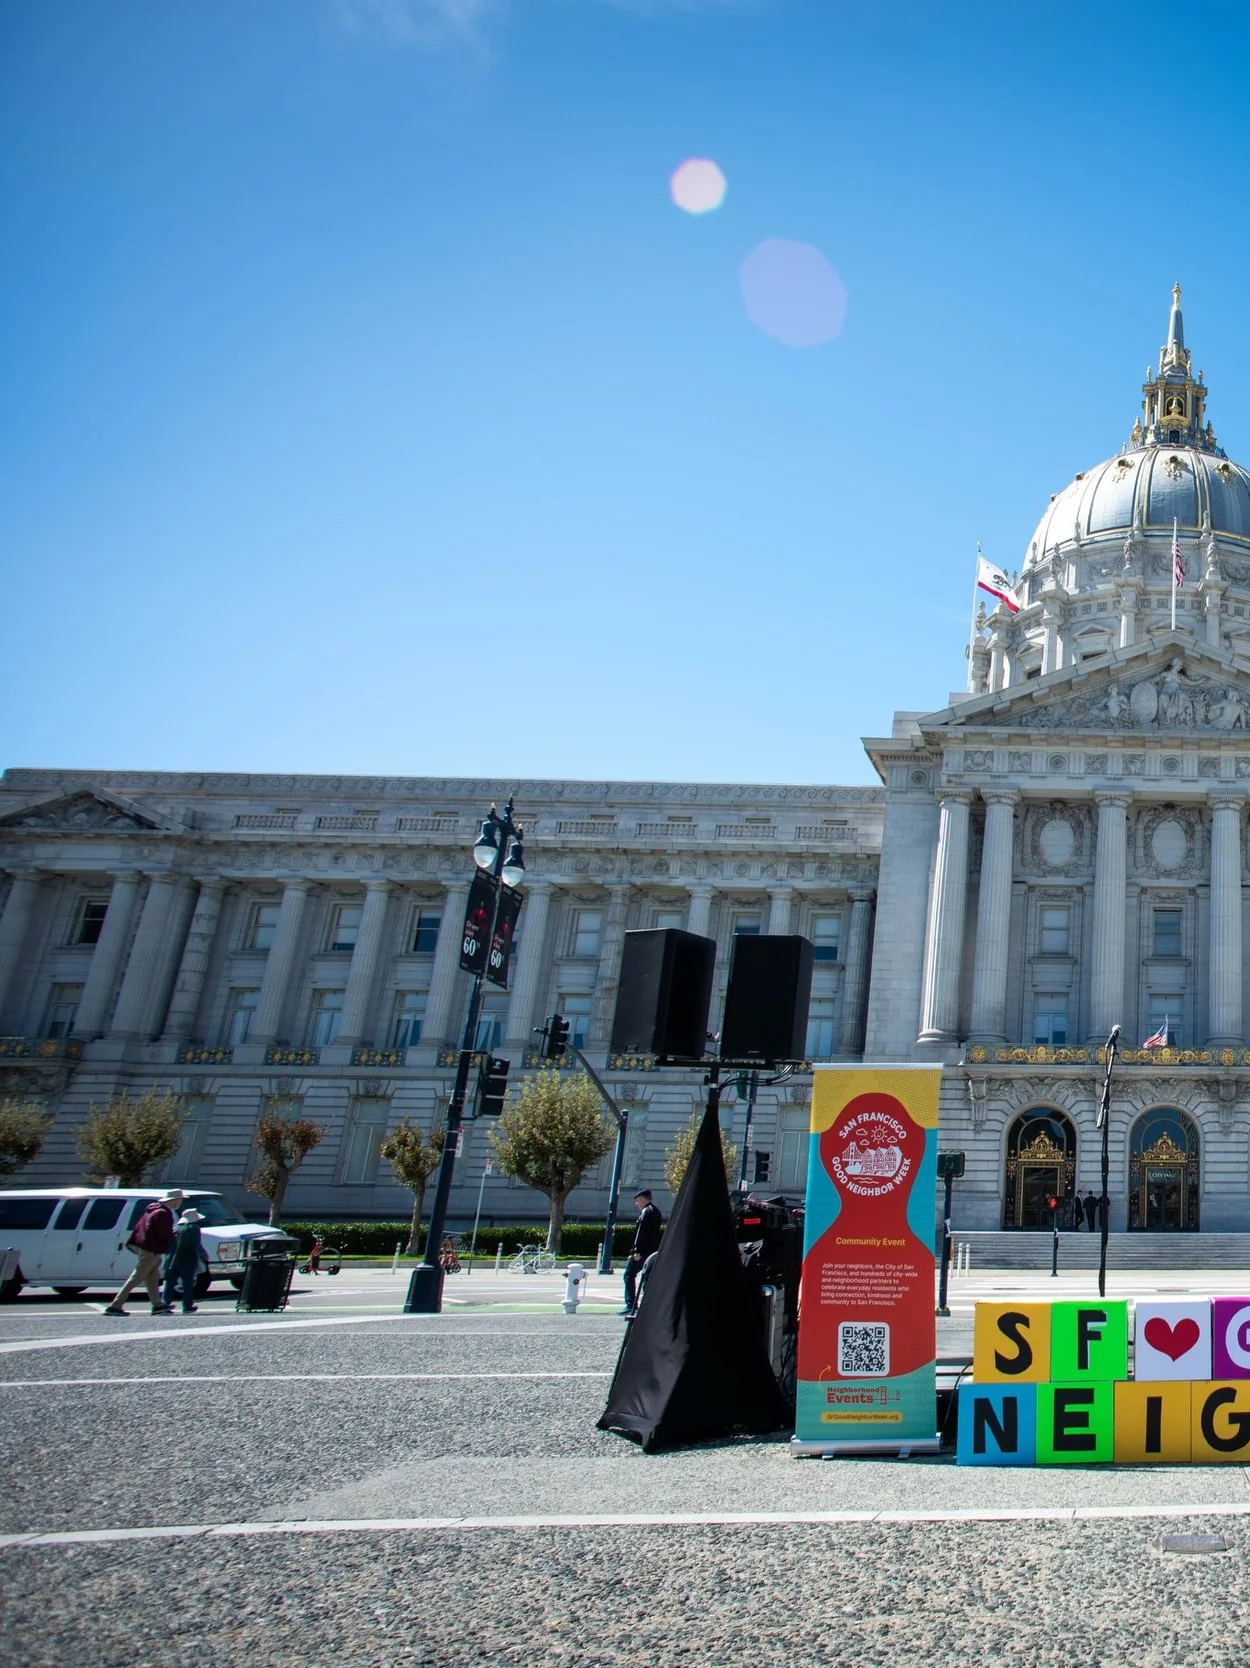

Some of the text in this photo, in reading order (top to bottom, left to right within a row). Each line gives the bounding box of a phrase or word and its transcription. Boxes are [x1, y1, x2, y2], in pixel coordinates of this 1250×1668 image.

[840, 1112, 907, 1140] SAN FRANCISCO
[832, 1156, 911, 1196] GOOD NEIGHBOR WEEK
[836, 1237, 905, 1247] Community Event
[994, 1309, 1108, 1375] SF
[827, 1393, 874, 1404] Events
